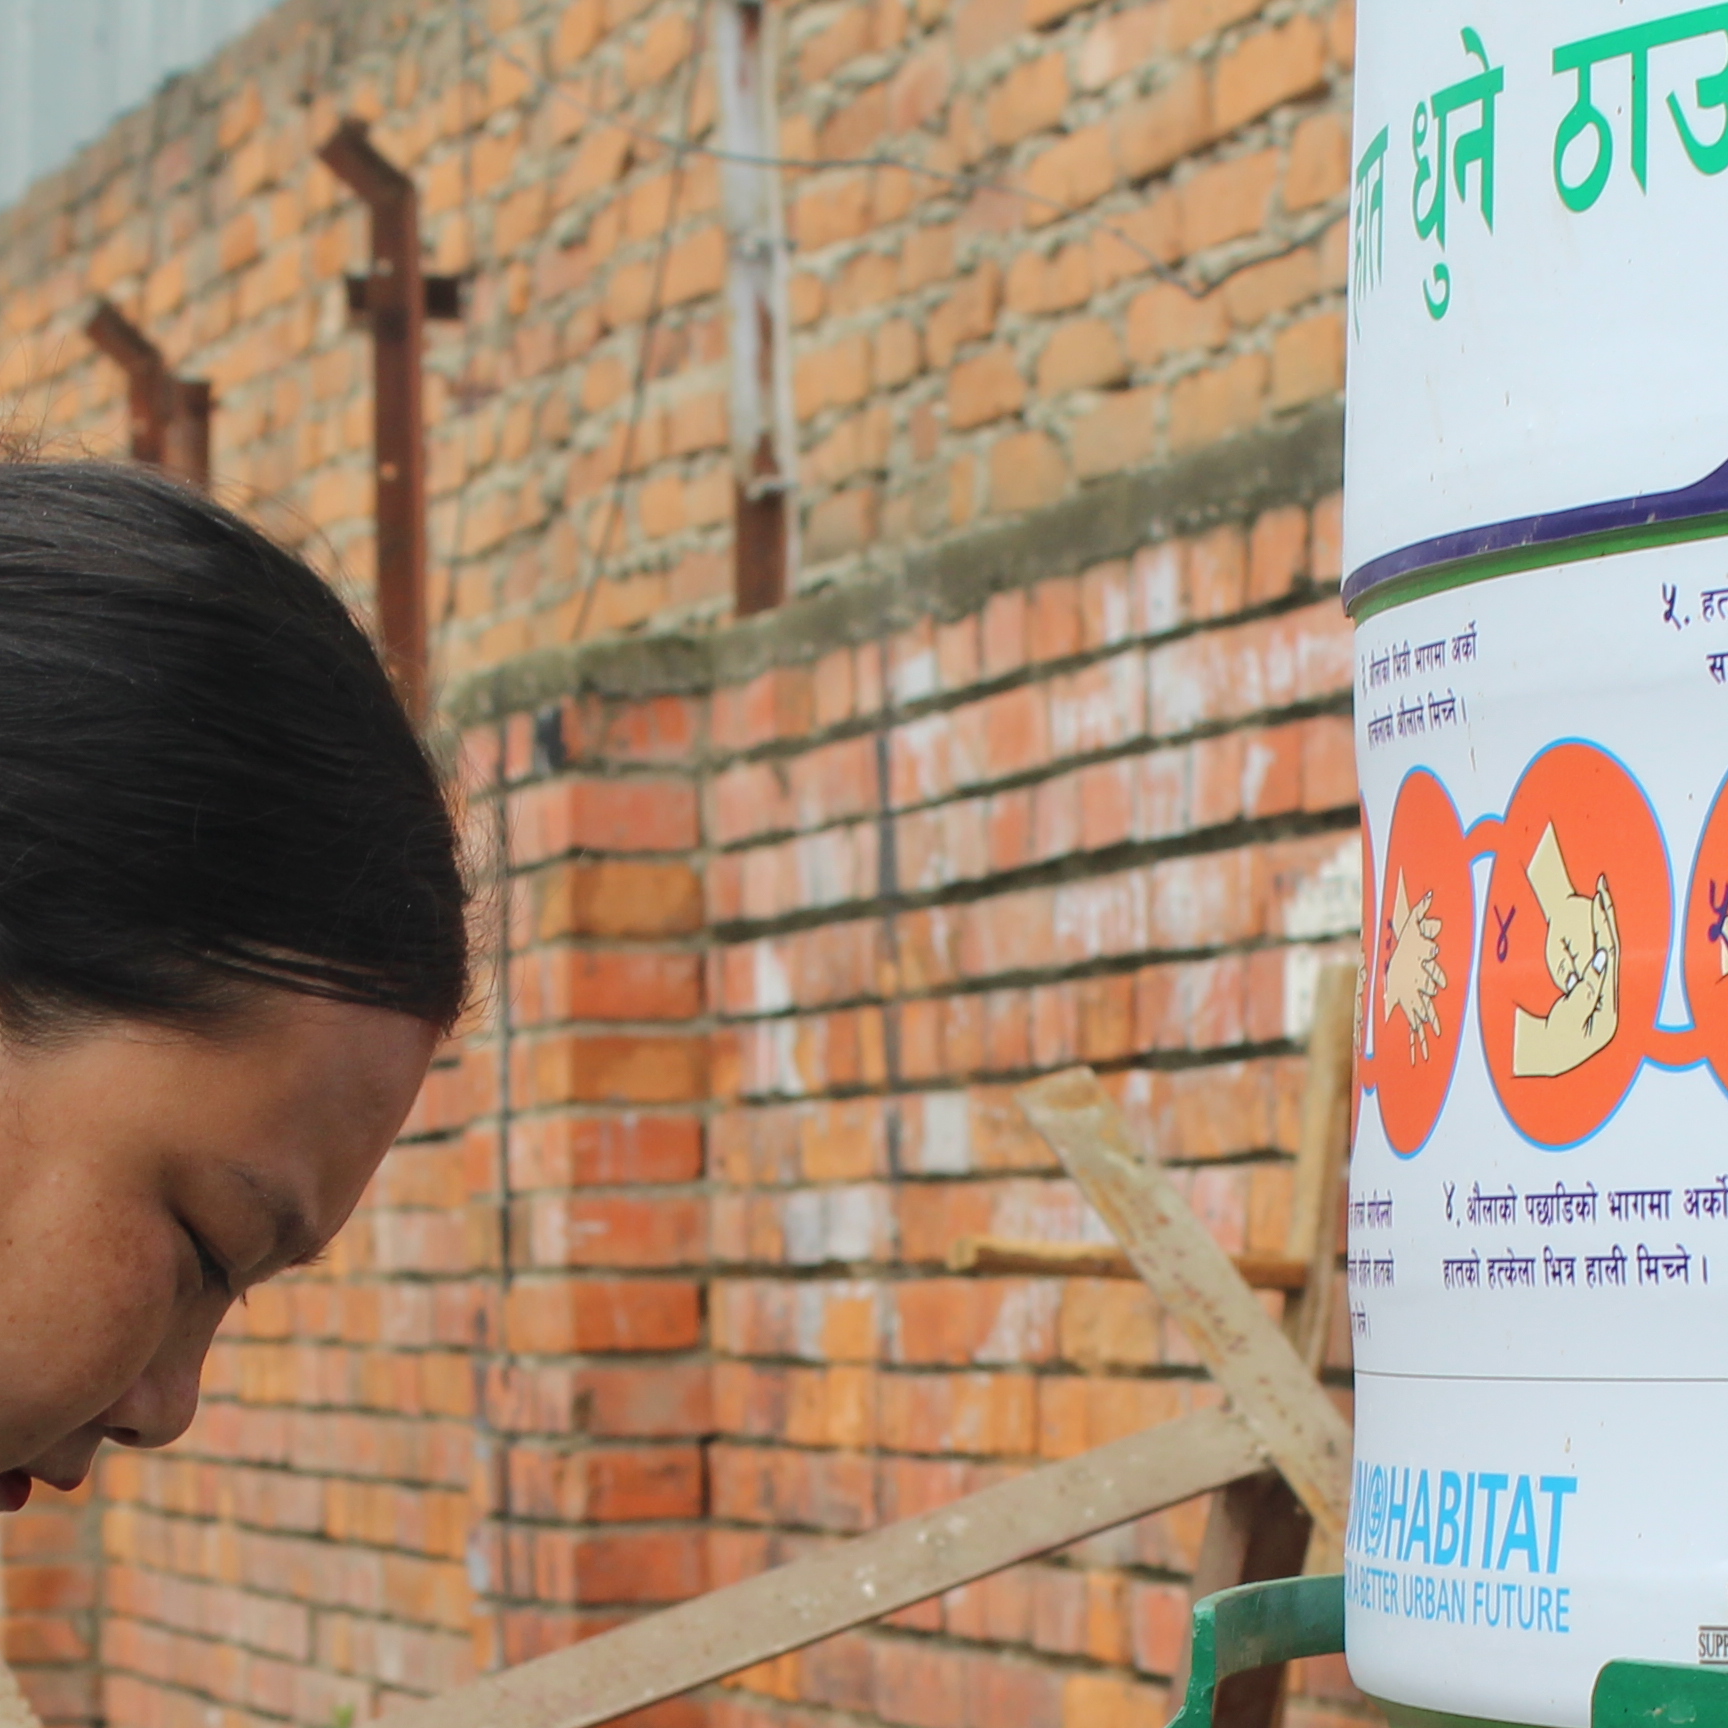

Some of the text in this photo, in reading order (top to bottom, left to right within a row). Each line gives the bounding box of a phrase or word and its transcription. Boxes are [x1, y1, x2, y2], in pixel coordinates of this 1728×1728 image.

[1412, 26, 1505, 321] धुने
[1493, 904, 1516, 963] ४
[1608, 1190, 1673, 1222] भागमा
[1443, 1247, 1480, 1290] हातको
[1486, 1247, 1536, 1290] हत्केला
[1543, 1245, 1577, 1288] भित्र
[1585, 1244, 1629, 1288] हाली
[1636, 1243, 1692, 1285] मिच्ने
[1384, 1466, 1578, 1575] HABITAT
[1361, 1565, 1399, 1616] BETTER
[1403, 1573, 1466, 1625] URBAN
[1473, 1581, 1570, 1634] FUTURE
